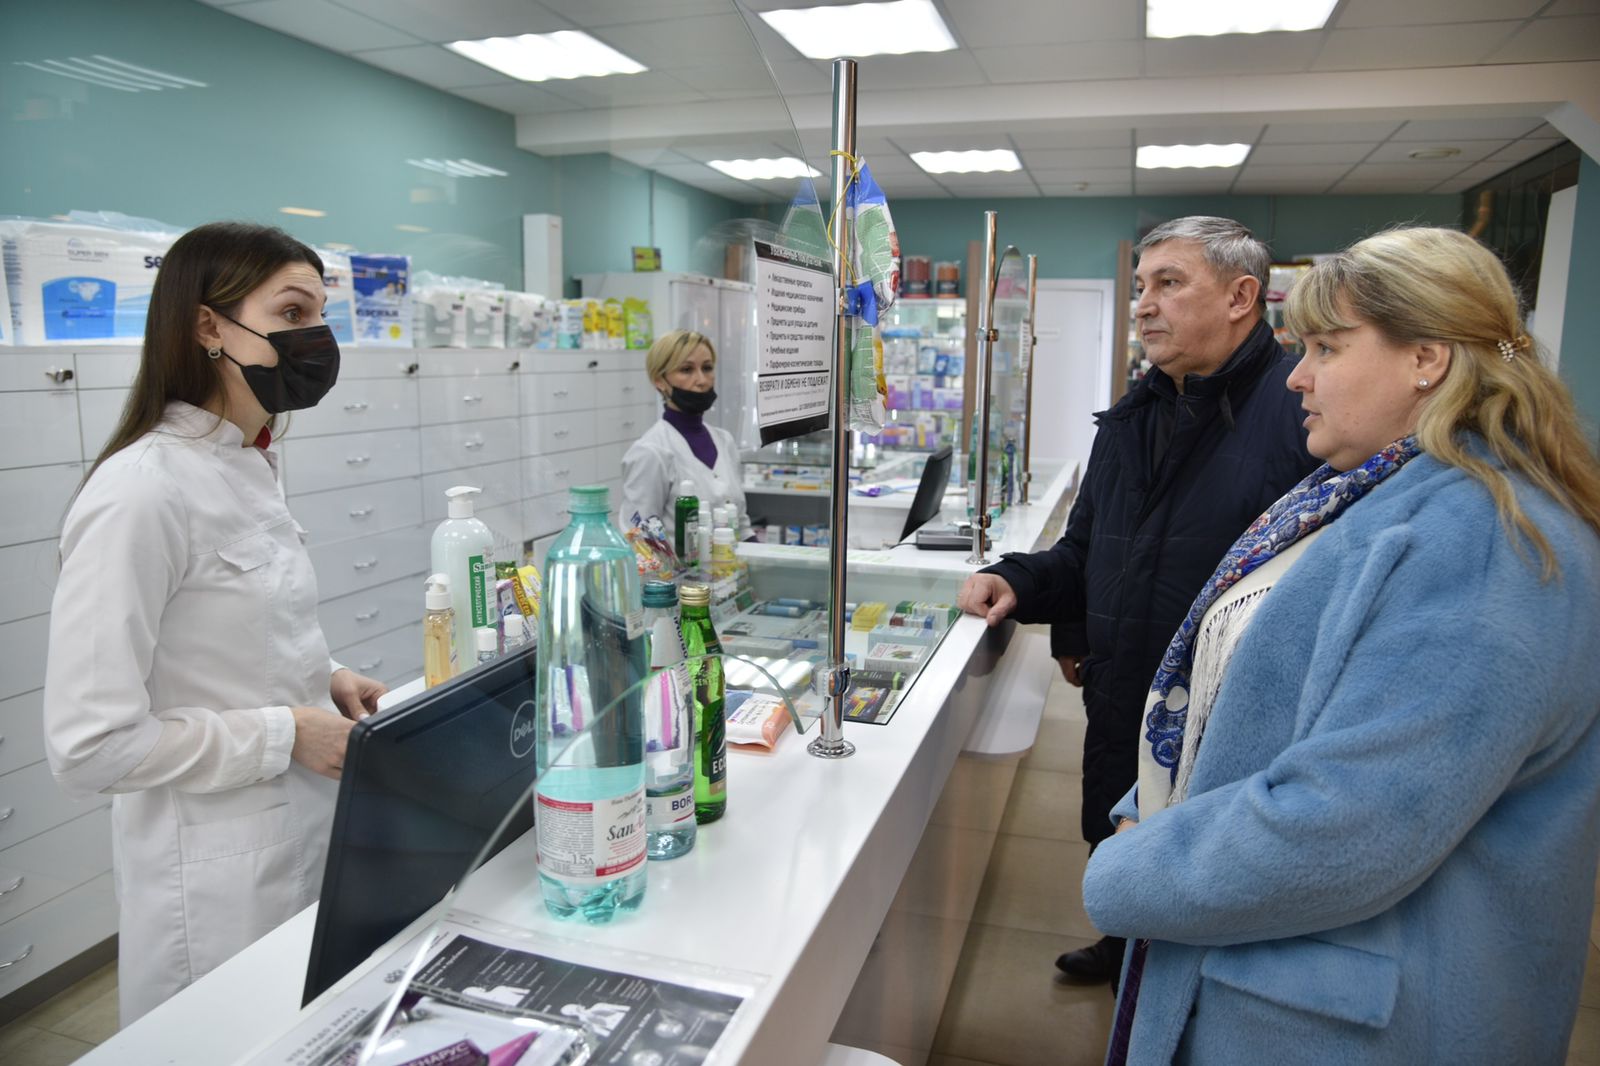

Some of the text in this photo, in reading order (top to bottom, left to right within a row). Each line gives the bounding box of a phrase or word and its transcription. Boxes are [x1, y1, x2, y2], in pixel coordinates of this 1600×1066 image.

[759, 379, 780, 392] ВОЗВРАТУ
[785, 377, 801, 389] ОБМЕНУ
[801, 376, 807, 387] НЕ
[808, 375, 829, 387] ПОДЛЕЖАТ
